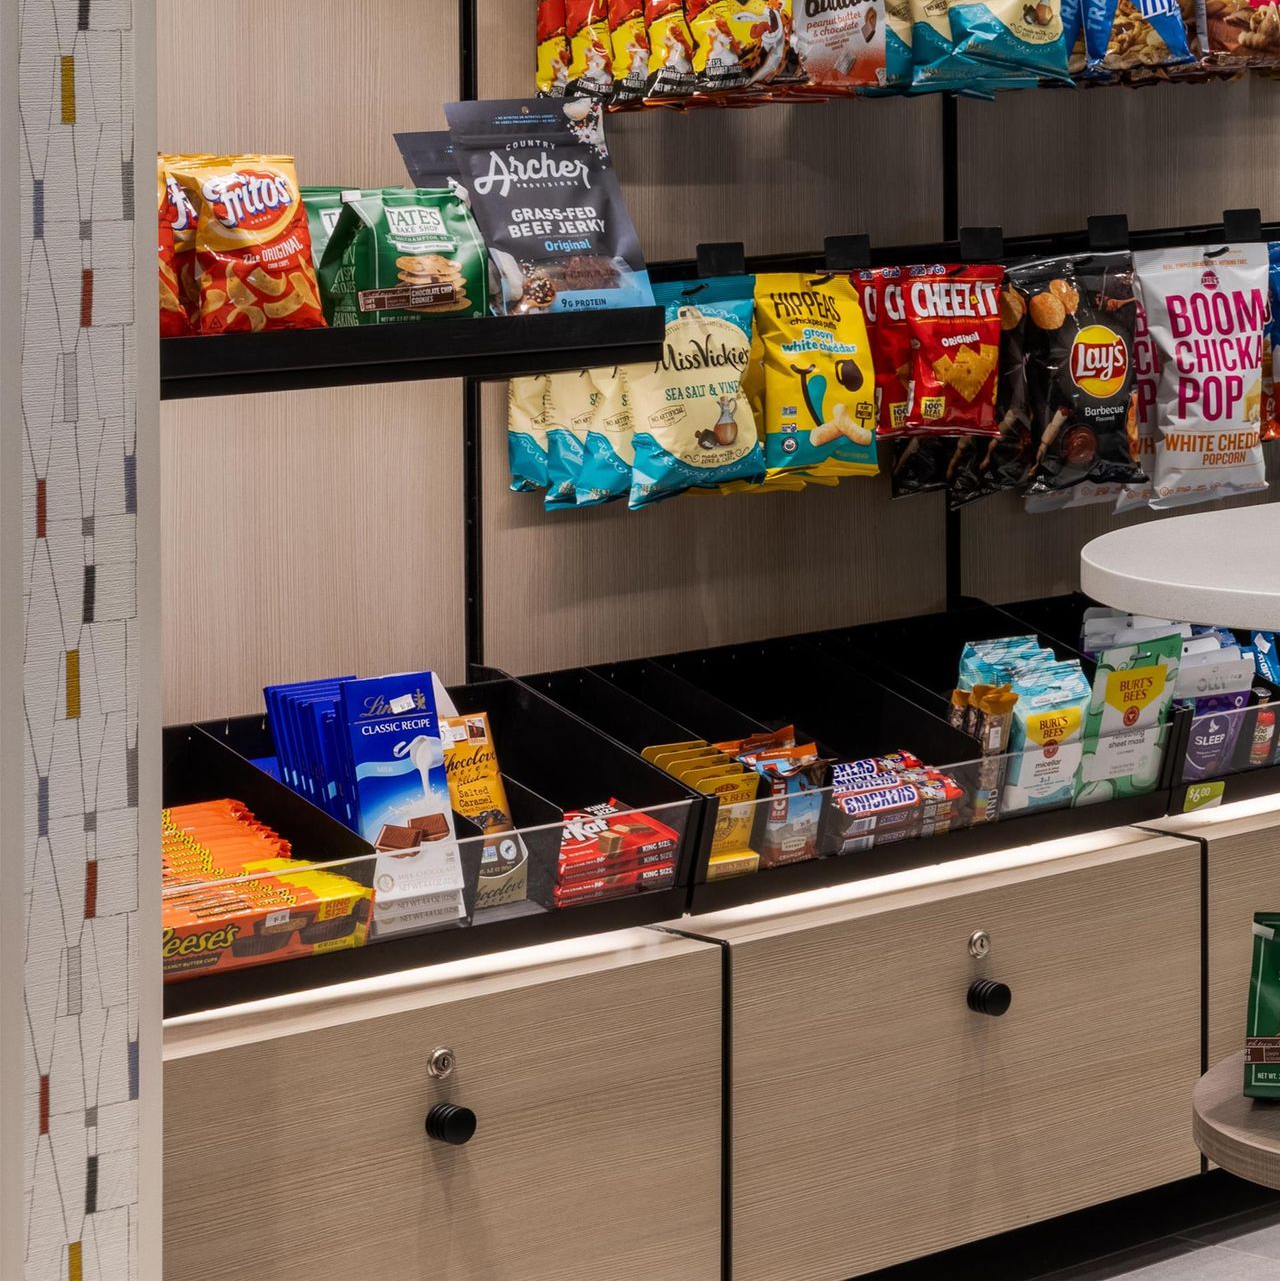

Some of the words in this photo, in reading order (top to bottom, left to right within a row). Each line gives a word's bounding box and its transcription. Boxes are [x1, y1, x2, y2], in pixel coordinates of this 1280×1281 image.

[474, 150, 591, 198] Archer
[202, 172, 290, 226] Fritos
[510, 207, 596, 222] GRASS-FED
[507, 221, 546, 238] BEEF
[550, 218, 605, 234] JERKY
[262, 237, 304, 262] ORIGINAL
[544, 237, 591, 252] Original
[573, 297, 607, 307] PROTEIN
[771, 291, 838, 324] HIPPEAS
[911, 280, 998, 317] CHEEZ-IT
[1166, 289, 1265, 339] BOOM
[781, 340, 817, 354] white
[820, 340, 857, 354] cheddar
[1177, 334, 1261, 374] CHICKA
[666, 388, 683, 401] SEA
[686, 386, 706, 400] SALT
[1178, 374, 1243, 421] POP
[1166, 434, 1212, 452] WHITE
[1202, 451, 1246, 465] POPCORN
[1120, 677, 1152, 691] BURT'S
[1123, 689, 1147, 702] BEES
[362, 723, 400, 735] CLASSIC
[402, 719, 430, 730] RECIPE
[842, 784, 916, 815] SNICKERS
[642, 869, 658, 880] KING
[659, 866, 674, 879] SIZE
